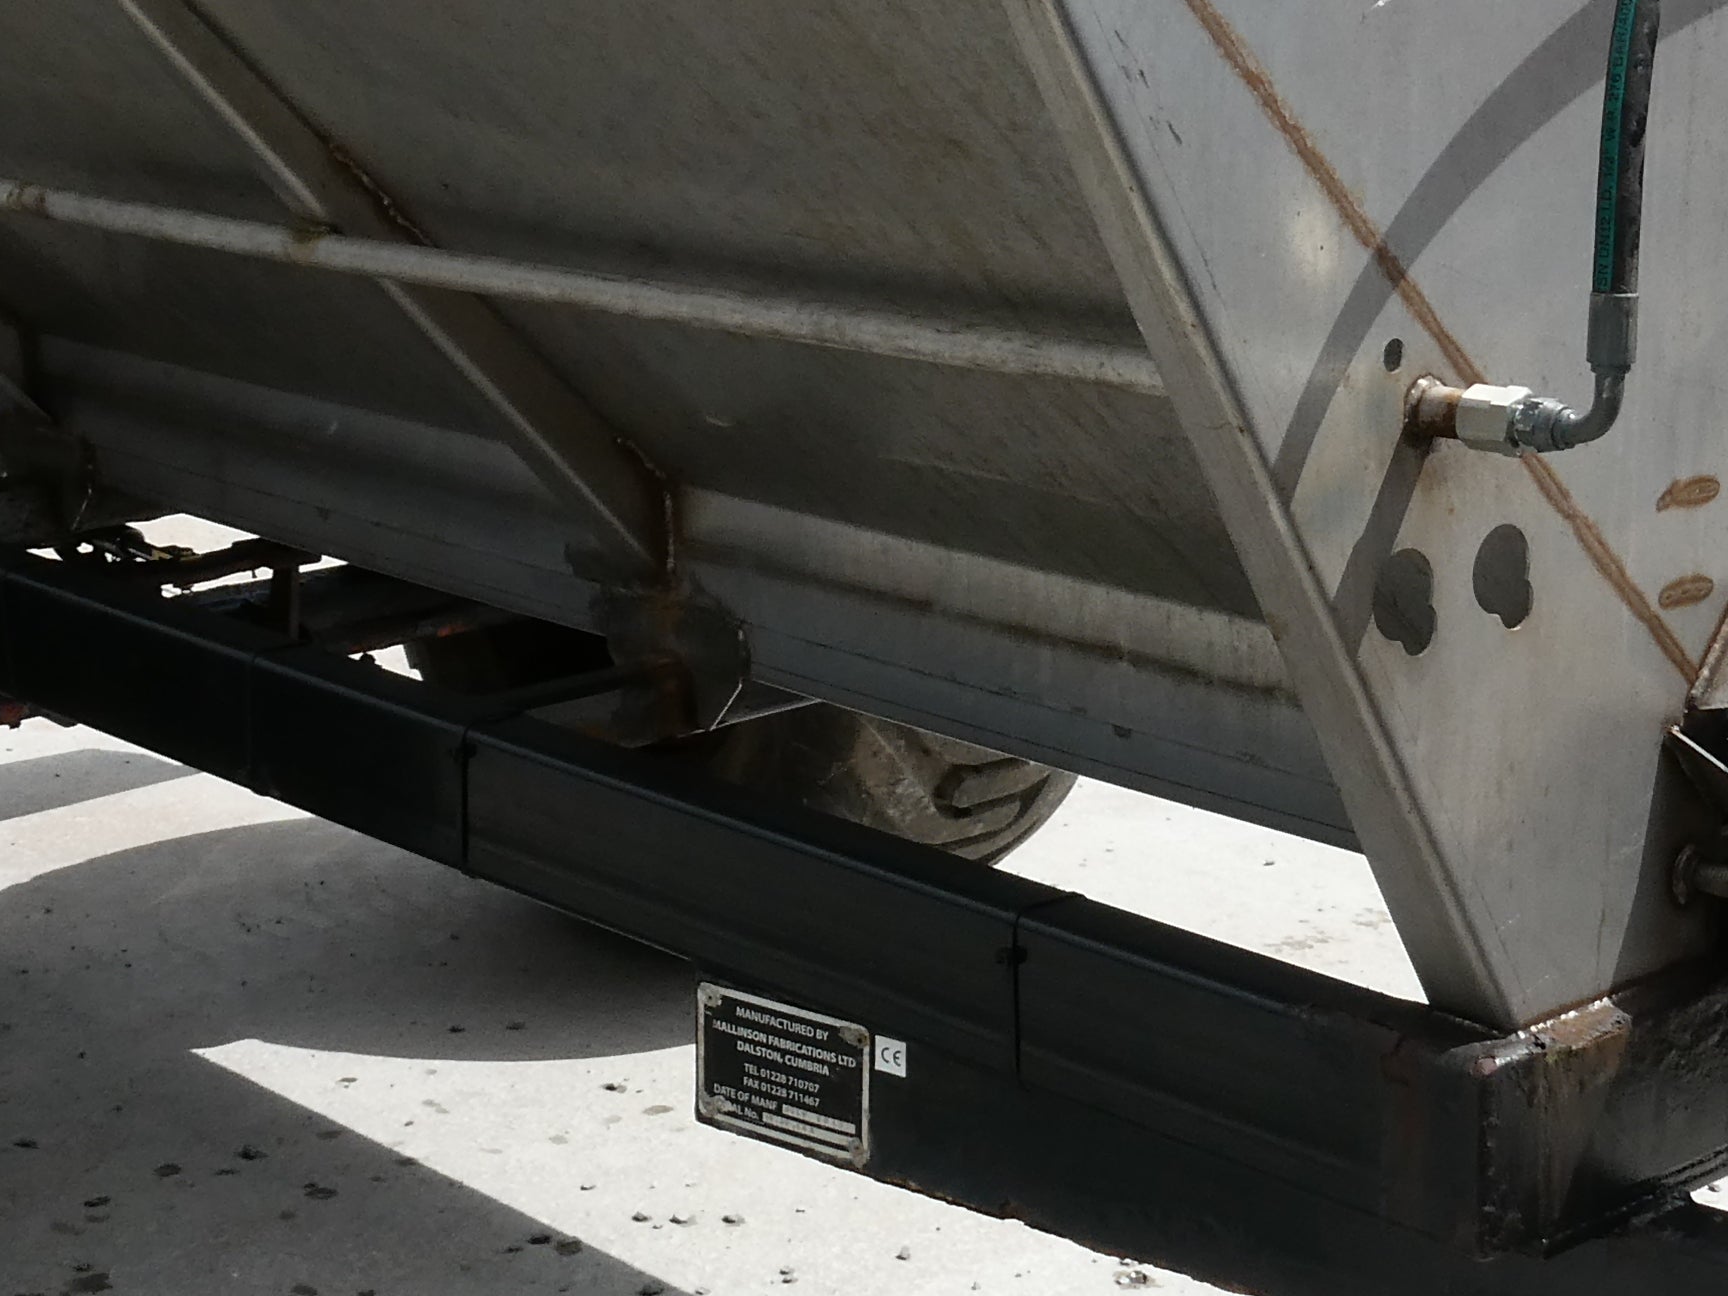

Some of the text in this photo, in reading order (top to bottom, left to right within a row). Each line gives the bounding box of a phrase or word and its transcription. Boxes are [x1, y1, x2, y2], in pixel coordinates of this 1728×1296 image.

[736, 1006, 829, 1040] MANUFACTURED BY
[713, 1019, 857, 1068] MALLINSON FABRICATIONS LTD
[737, 1040, 830, 1076] DALSTON, CUMBRIA
[881, 1047, 901, 1067] CE
[713, 1083, 736, 1099] DATE
[737, 1091, 750, 1103] OF
[743, 1077, 759, 1090] FAX
[744, 1063, 820, 1093] TEL 01228 710707
